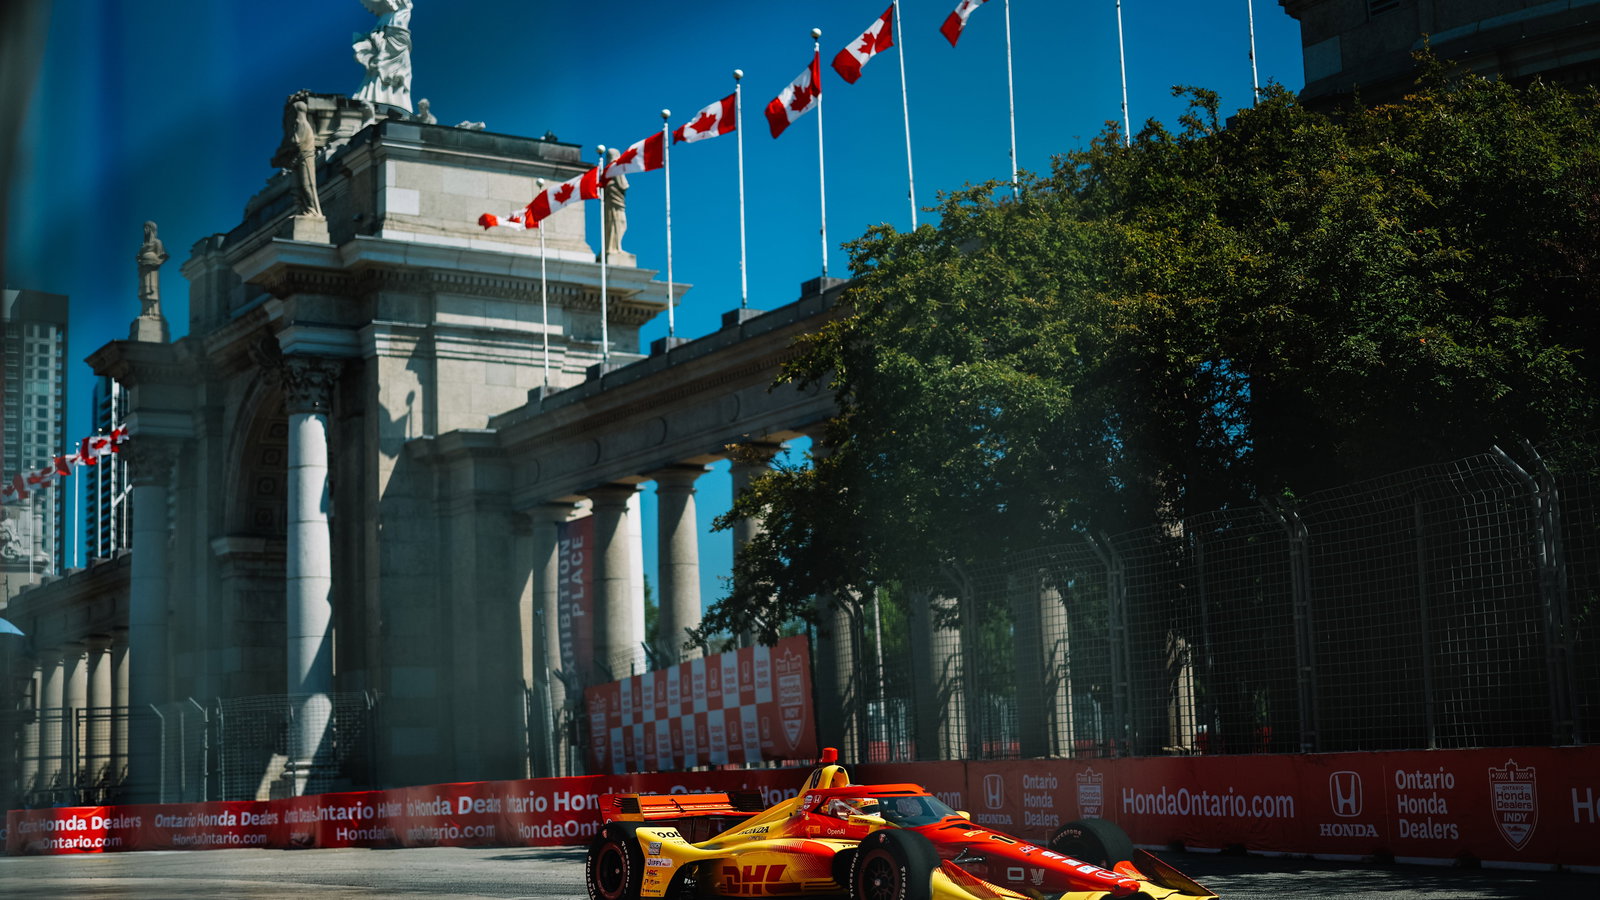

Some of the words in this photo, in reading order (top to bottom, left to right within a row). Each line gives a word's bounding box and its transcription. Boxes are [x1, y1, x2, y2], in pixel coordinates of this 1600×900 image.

[571, 535, 584, 617] PLACE
[1022, 773, 1058, 790] Ontario
[1394, 766, 1455, 790] Ontario
[1023, 791, 1054, 809] Honda
[1121, 786, 1295, 819] HondaOntario.com
[1396, 792, 1448, 815] Honda
[1496, 792, 1531, 800] Honda
[1497, 801, 1533, 809] Dealers
[91, 814, 142, 833] Dealers
[198, 809, 237, 826] Honda
[977, 813, 1013, 825] HONDA
[1023, 810, 1060, 827] Dealers
[1503, 812, 1528, 823] INDY
[826, 827, 846, 836] OpenAI
[1319, 823, 1379, 838] HONDA
[1398, 817, 1460, 840] Dealers
[722, 864, 800, 895] DHL
